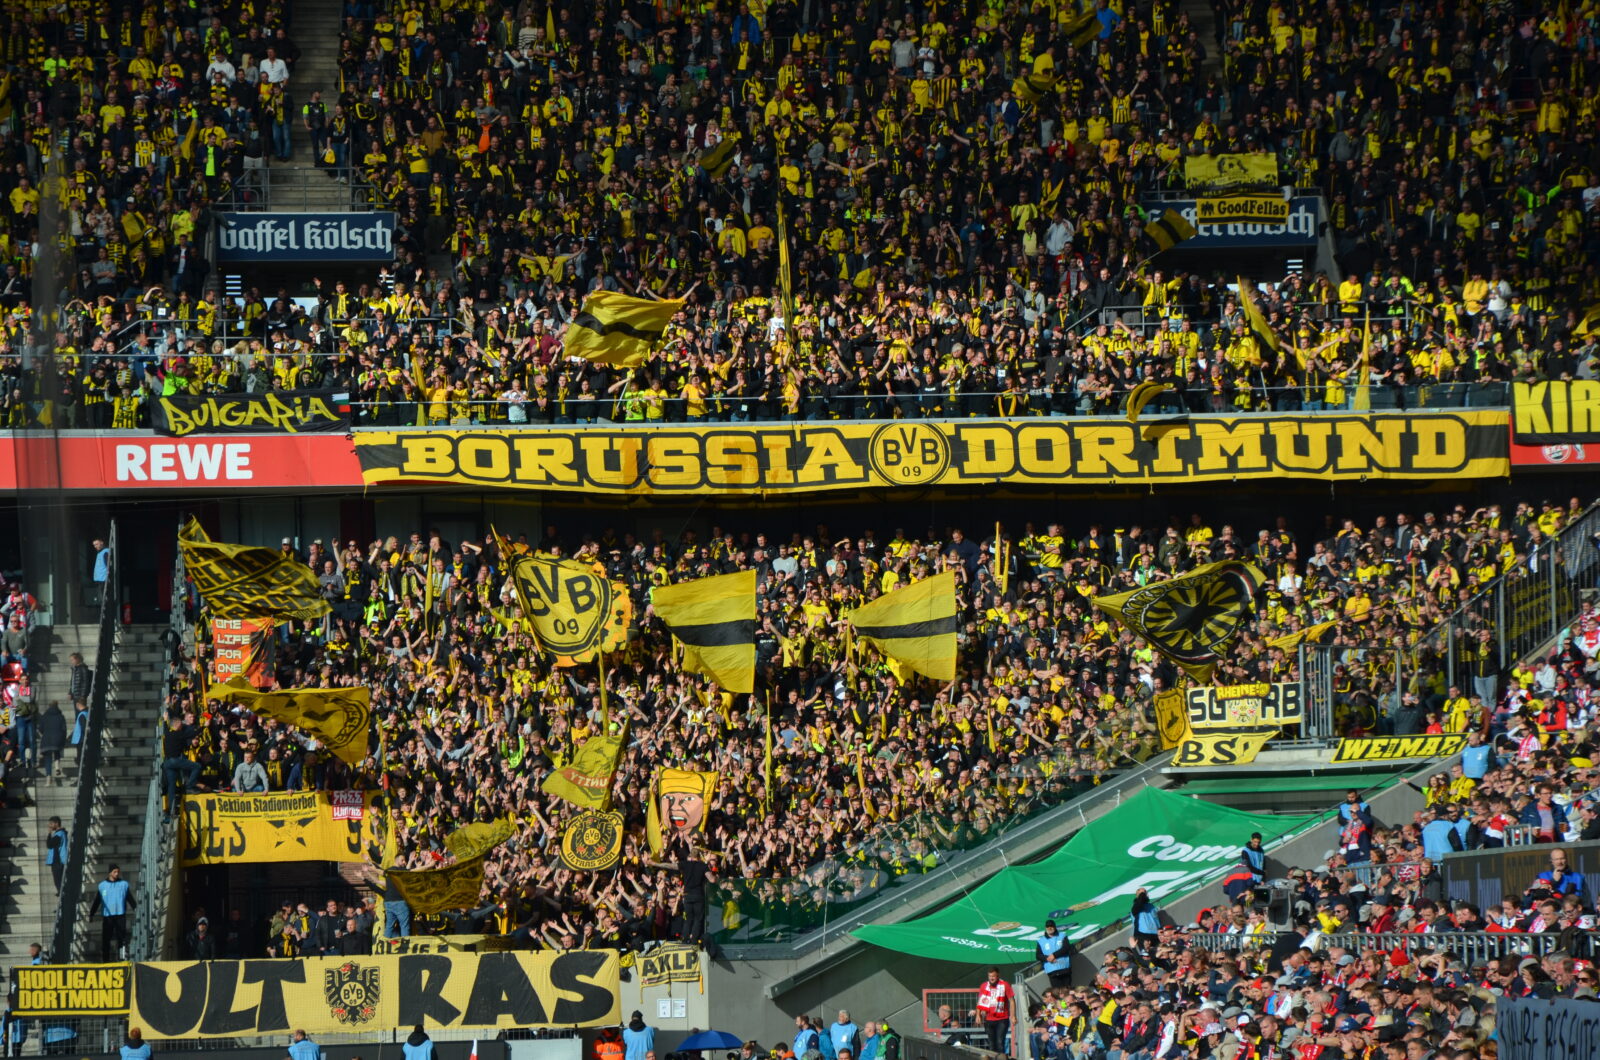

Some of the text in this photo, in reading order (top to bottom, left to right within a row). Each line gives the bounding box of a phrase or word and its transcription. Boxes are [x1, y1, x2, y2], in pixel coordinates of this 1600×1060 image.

[1217, 200, 1286, 217] GoodFellas
[303, 219, 392, 254] Kölsch
[882, 427, 940, 465] BVB
[960, 419, 1466, 478] DORTMUND
[116, 443, 253, 481] REWE
[401, 433, 865, 485] BORUSSIA
[901, 465, 922, 476] 09
[520, 565, 597, 617] BVB
[553, 618, 580, 636] 09
[217, 634, 250, 645] LIFE
[217, 649, 242, 659] FOR
[217, 663, 242, 673] ONE
[1341, 736, 1462, 760] WEIMAR
[217, 798, 252, 813] Sektion
[253, 794, 317, 813] Stadionverbot
[567, 851, 616, 868] ULTRAS 2001
[642, 951, 699, 977] AKLP
[18, 968, 125, 990] HOOLIGANS
[18, 988, 125, 1010] DORTMUND
[343, 983, 363, 1000] BVB
